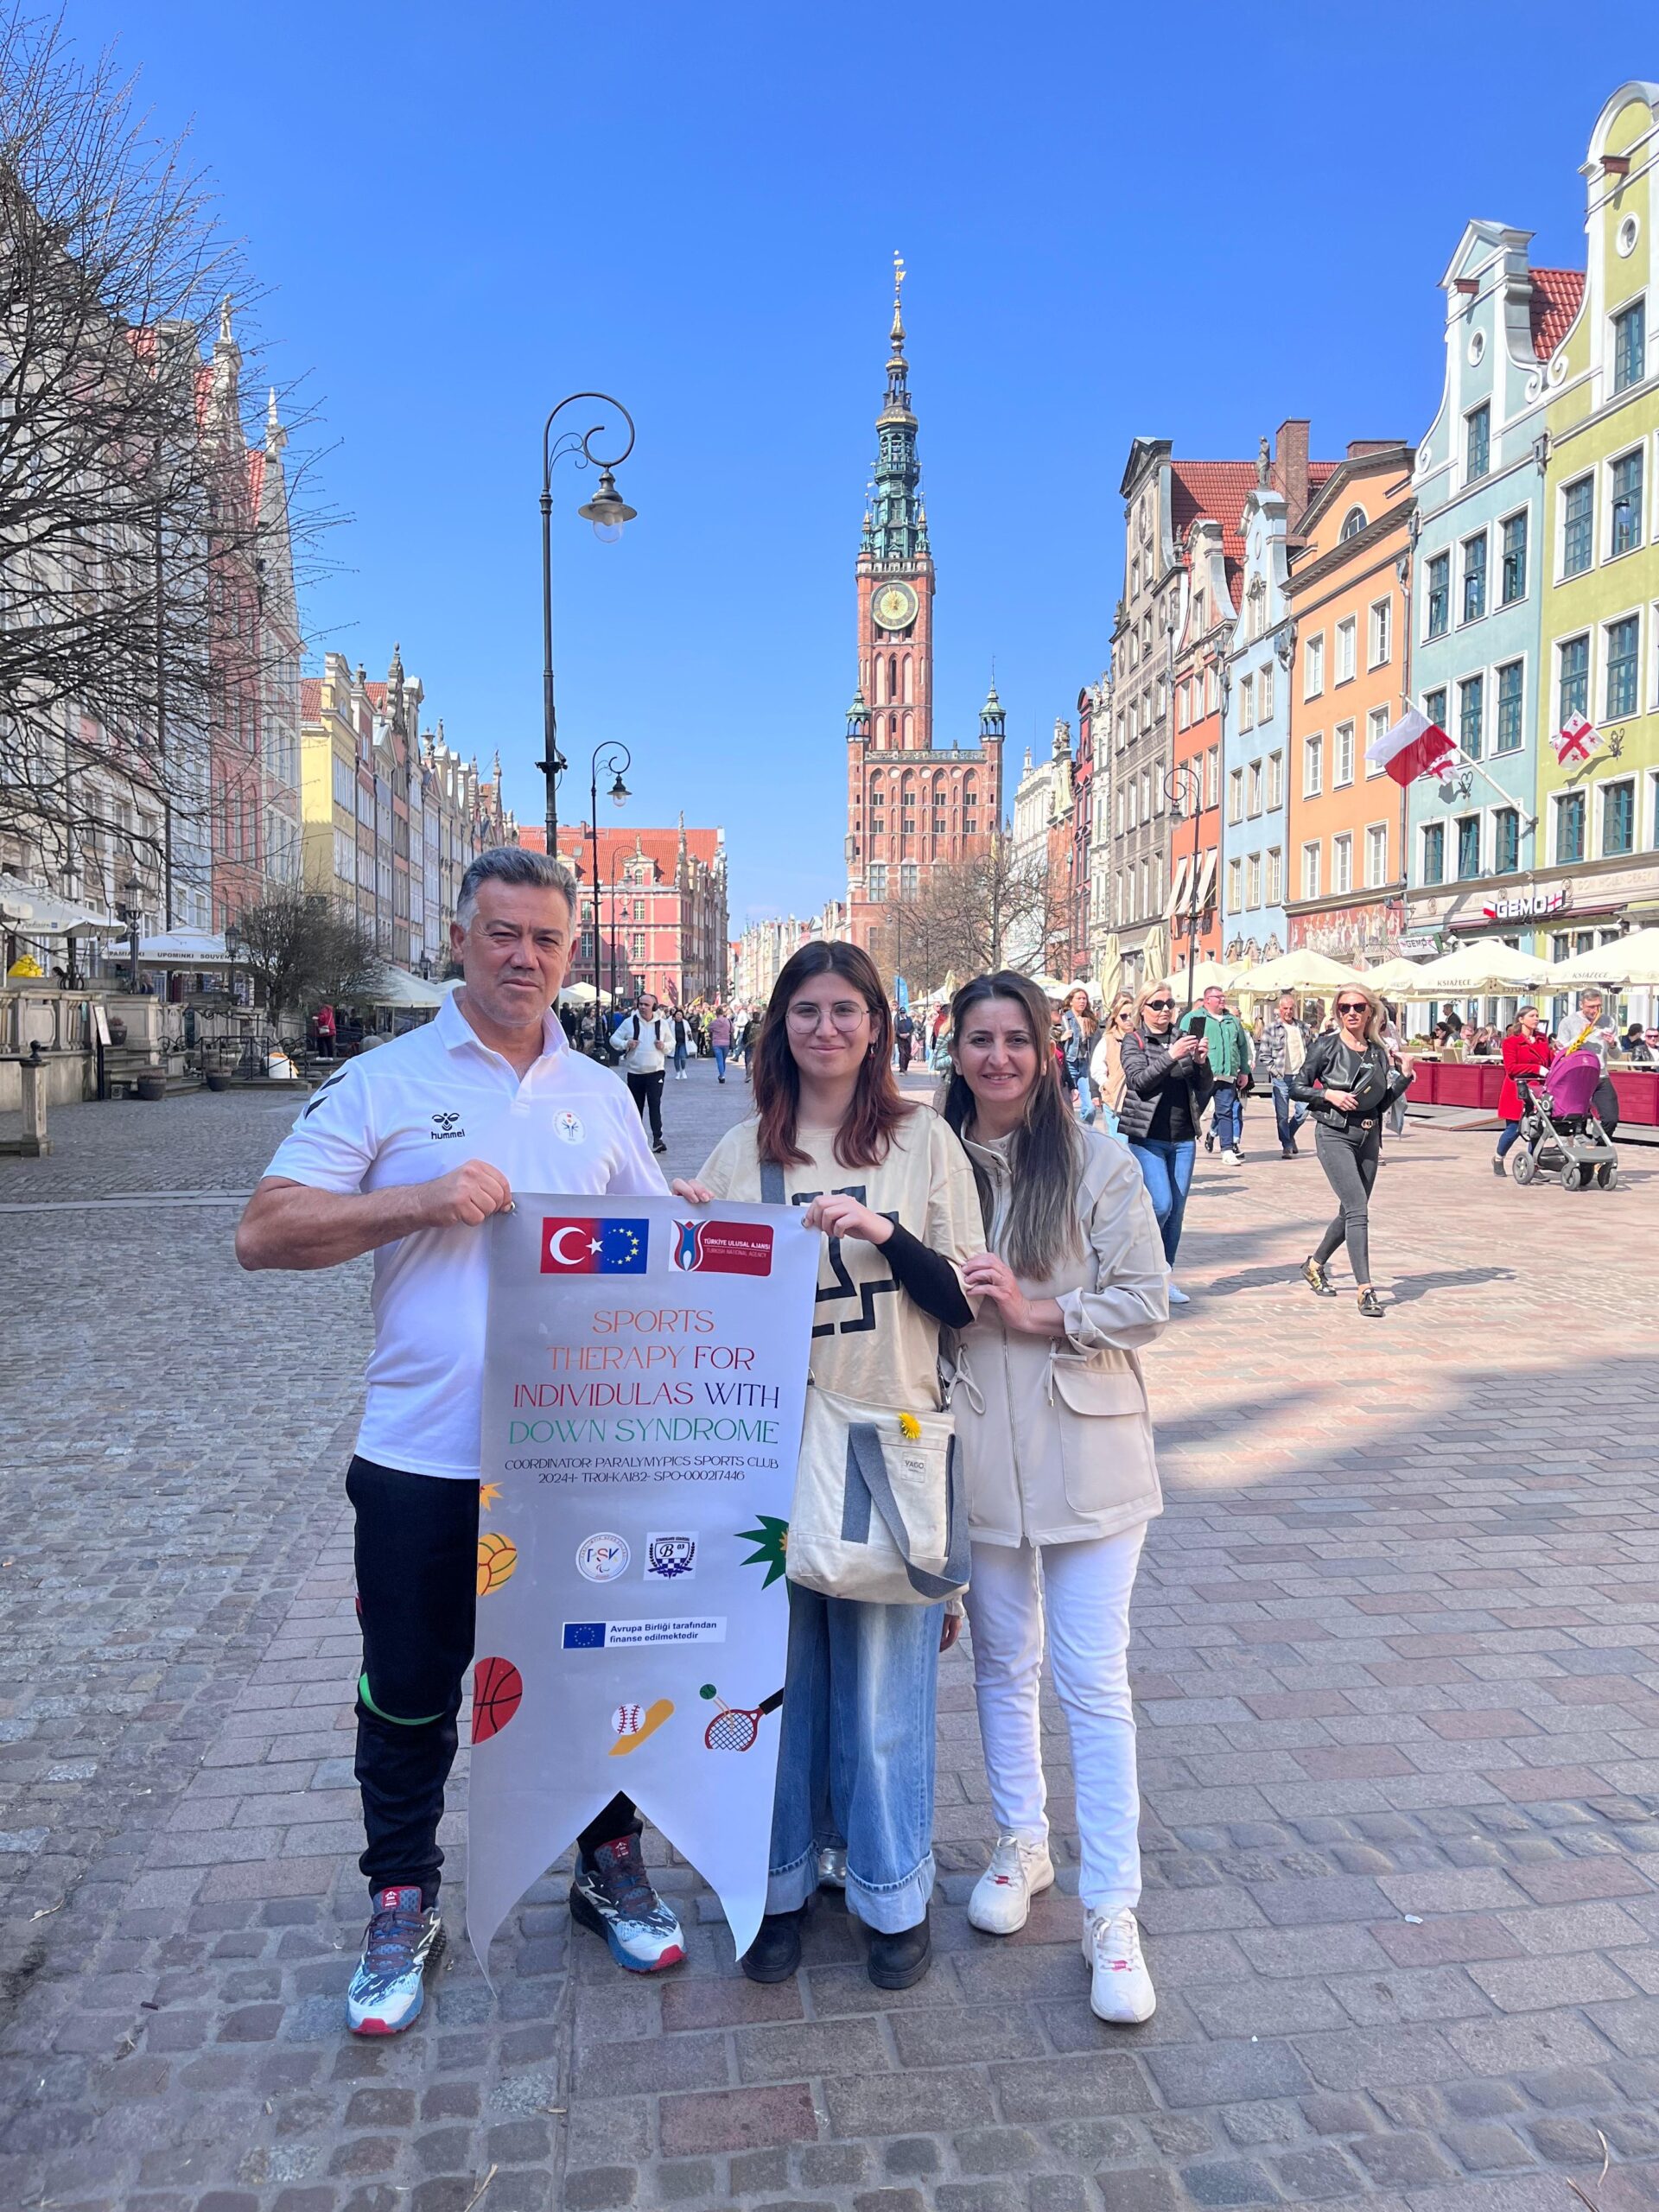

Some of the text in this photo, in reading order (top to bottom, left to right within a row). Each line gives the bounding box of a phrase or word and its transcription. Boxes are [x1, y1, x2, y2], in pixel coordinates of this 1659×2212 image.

[1496, 898, 1546, 918] GEMO
[1405, 939, 1427, 948] GEMO
[431, 1128, 466, 1140] hummel
[704, 1237, 727, 1246] TÜRKİYE
[592, 1309, 715, 1333] SPORTS
[546, 1345, 755, 1370] THERAPY FOR
[512, 1382, 779, 1408] INDIVIDULAS WITH
[509, 1418, 779, 1445] DOWN SYNDROME
[505, 1456, 779, 1471] COORDINATOR: PARALYMYPICS SPORTS CLUB
[659, 1543, 674, 1558] B
[610, 1621, 717, 1634] Avrupa Birliği tarafından
[609, 1632, 698, 1643] finanse edilmektedir
